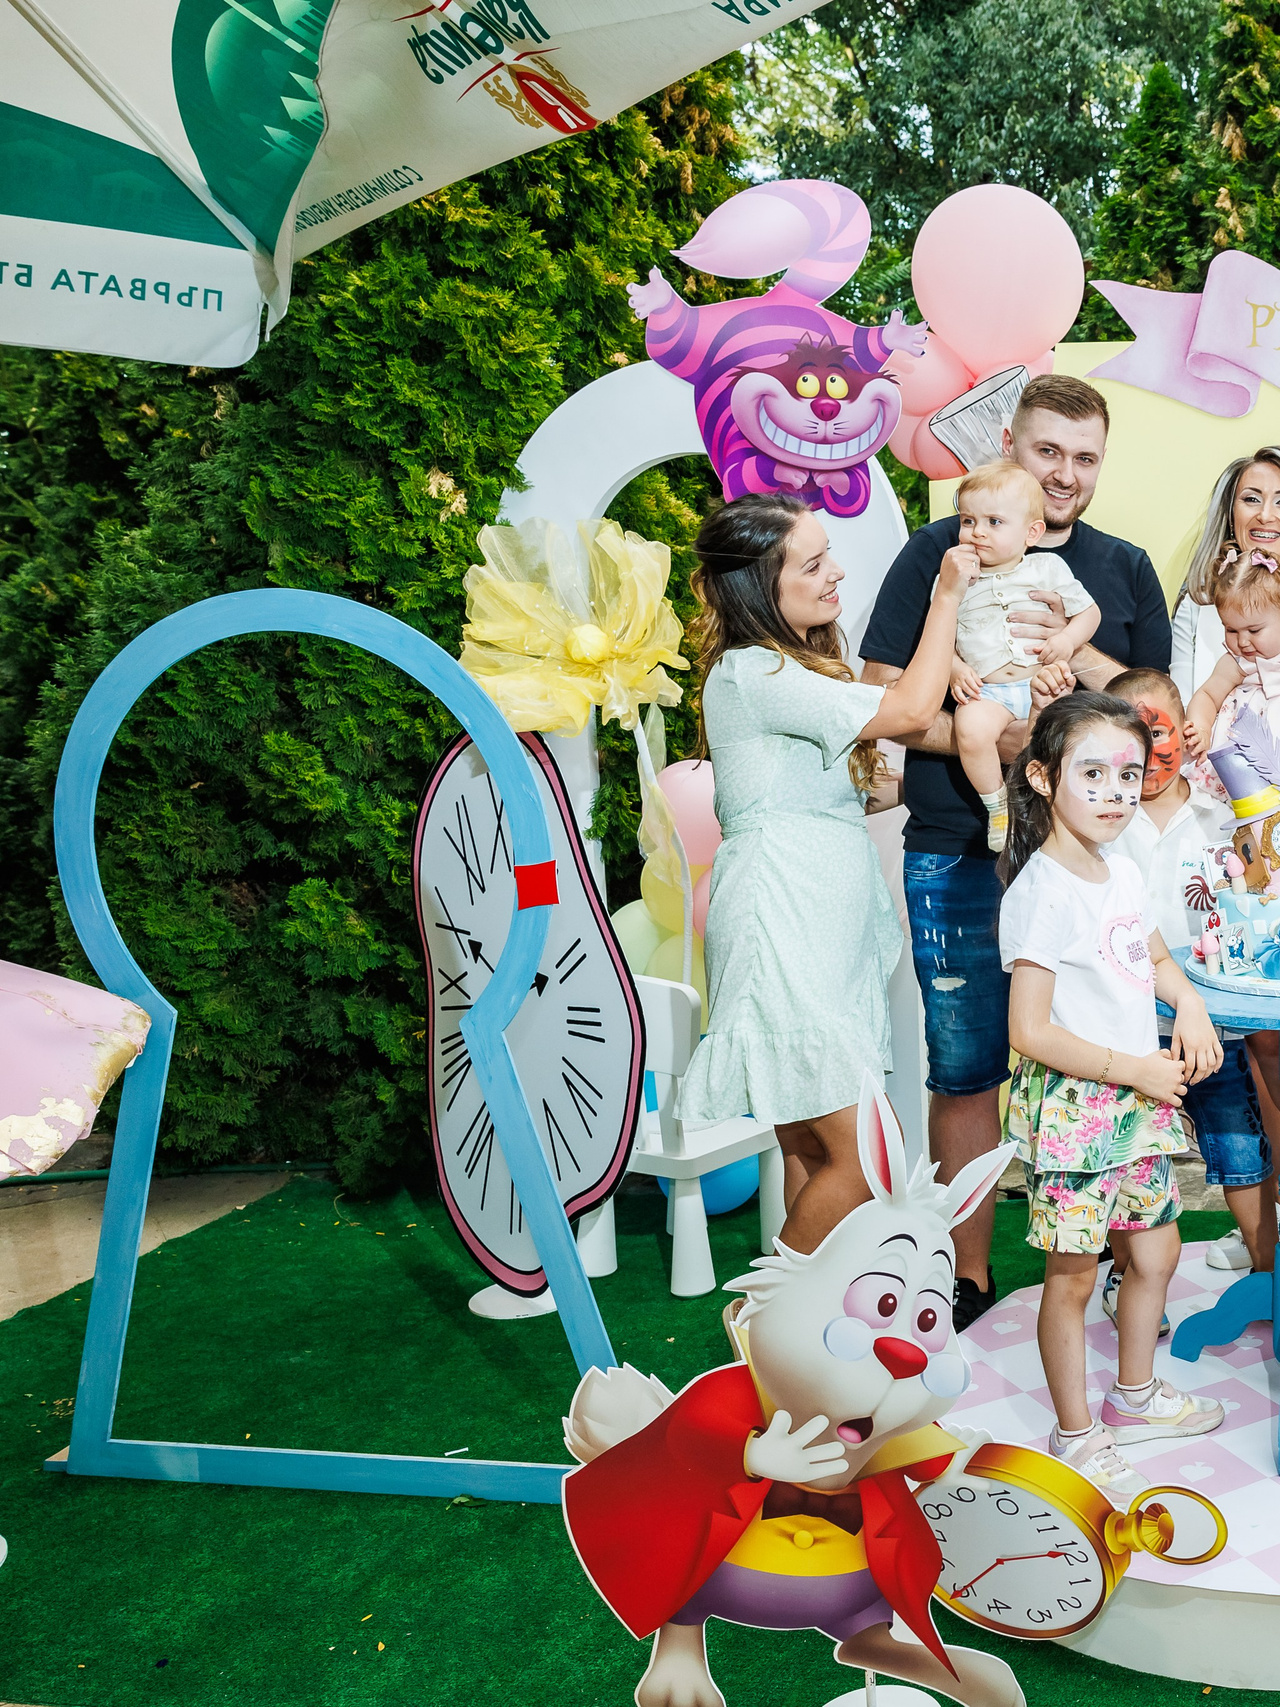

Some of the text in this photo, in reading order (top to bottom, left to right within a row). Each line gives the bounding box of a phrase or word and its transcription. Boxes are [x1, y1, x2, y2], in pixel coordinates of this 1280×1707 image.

[948, 1487, 976, 1503] 9
[987, 1489, 1019, 1515] 10
[923, 1503, 953, 1520] 8
[1028, 1511, 1060, 1533] 11
[1054, 1540, 1089, 1566] 12
[1068, 1577, 1092, 1586] 1
[987, 1598, 1012, 1615] 4
[1057, 1596, 1082, 1612] 2
[1027, 1608, 1053, 1624] 3
